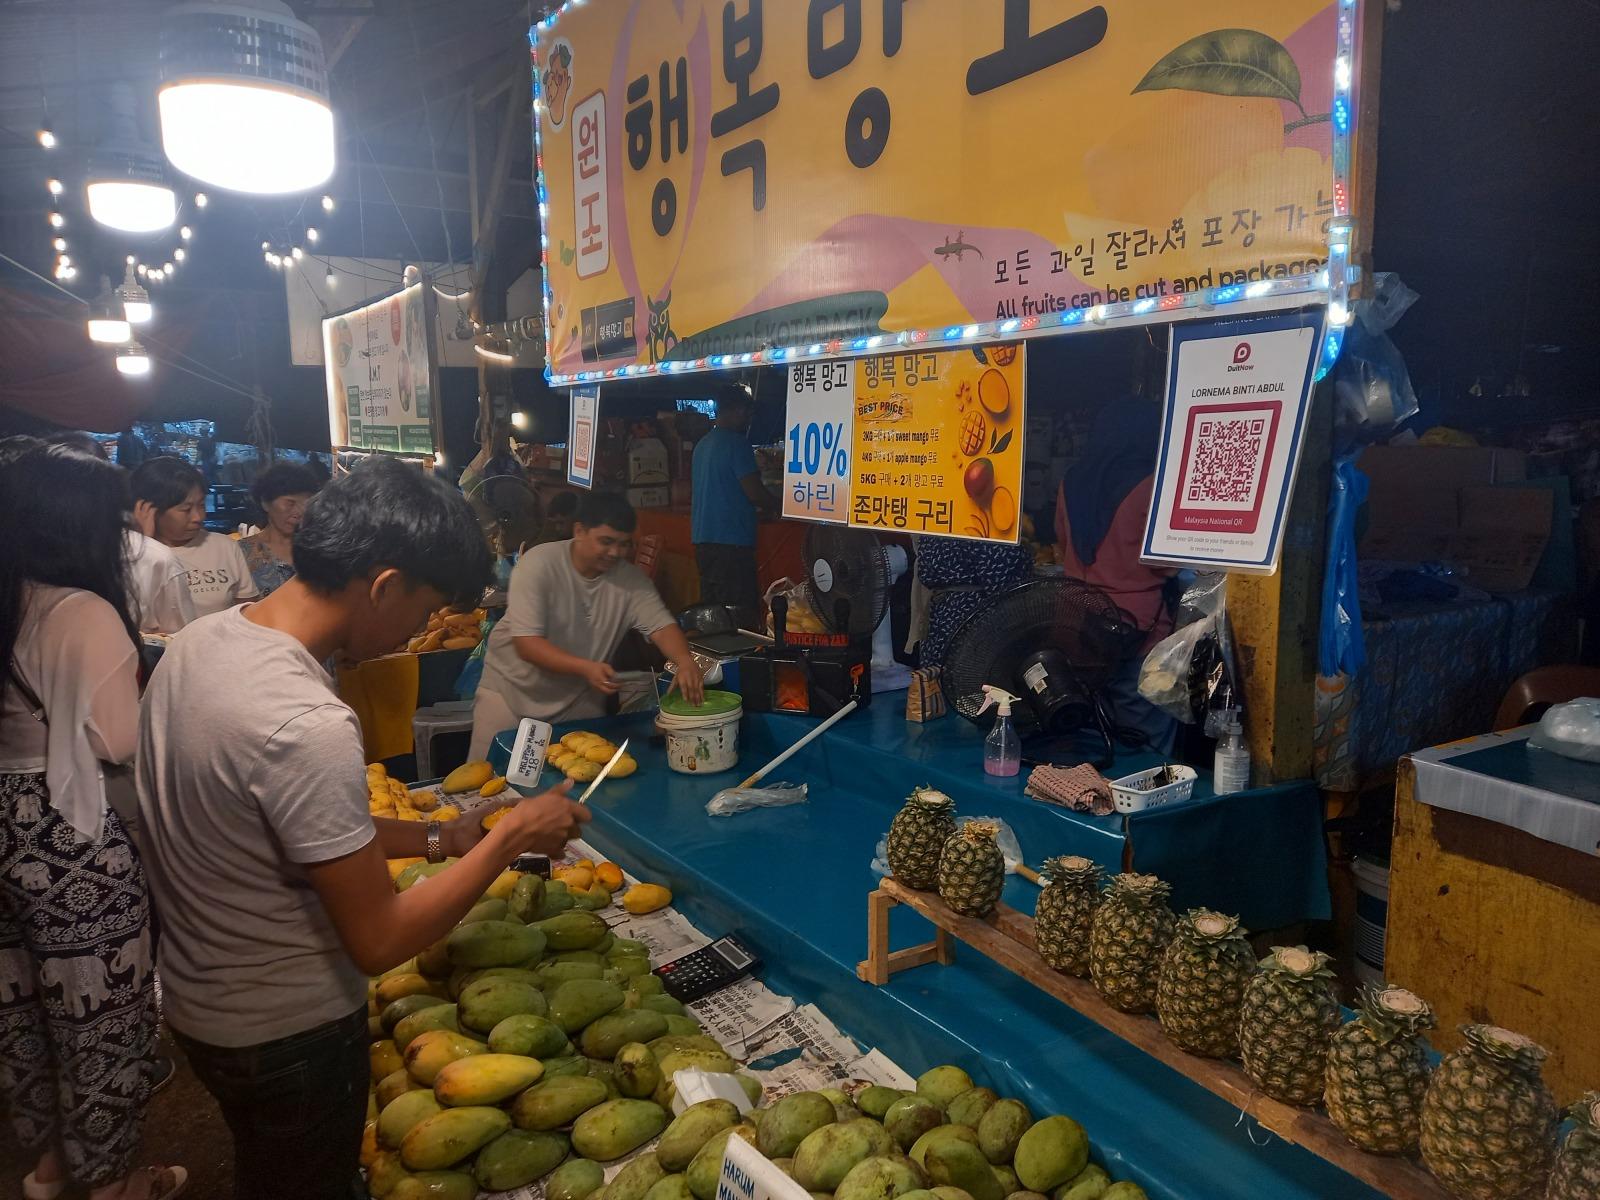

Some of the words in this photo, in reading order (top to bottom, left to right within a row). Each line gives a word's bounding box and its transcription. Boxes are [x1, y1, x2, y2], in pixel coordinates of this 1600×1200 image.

[995, 250, 1031, 285] 모든
[1051, 238, 1094, 276] 과일
[1202, 208, 1262, 248] 포장
[996, 299, 1019, 319] All
[1022, 292, 1067, 316] fruits
[1071, 291, 1102, 309] can
[1107, 283, 1130, 303] be
[1135, 277, 1167, 299] cut
[1173, 267, 1213, 292] and
[682, 333, 739, 356] Partner
[745, 320, 762, 347] of
[793, 364, 817, 393] 행복
[822, 363, 848, 392] 망고
[865, 356, 897, 389] 행복
[903, 354, 939, 387] 망고
[1227, 364, 1254, 373] DuitNow
[1191, 385, 1231, 398] LORNEMA
[1233, 384, 1256, 395] BINTI
[1256, 382, 1285, 393] ABDUL
[858, 402, 878, 416] BEST
[880, 401, 904, 416] PRICE
[896, 430, 911, 442] sweet
[912, 431, 929, 445] mango
[788, 422, 847, 478] 10%
[895, 453, 909, 466] apple
[910, 454, 928, 466] mango
[860, 473, 877, 485] 5KG
[900, 473, 912, 487] 2개
[915, 474, 928, 488] 망고
[931, 474, 945, 488] 무료
[793, 481, 835, 512] 하린
[854, 495, 908, 528] 존맛탱
[916, 499, 954, 534] 구리
[1184, 516, 1208, 526] Malaysia
[1209, 518, 1233, 526] National
[1233, 518, 1243, 526] QR
[187, 569, 229, 586] ESS
[528, 758, 540, 771] 18
[723, 1157, 756, 1200] HARUM
